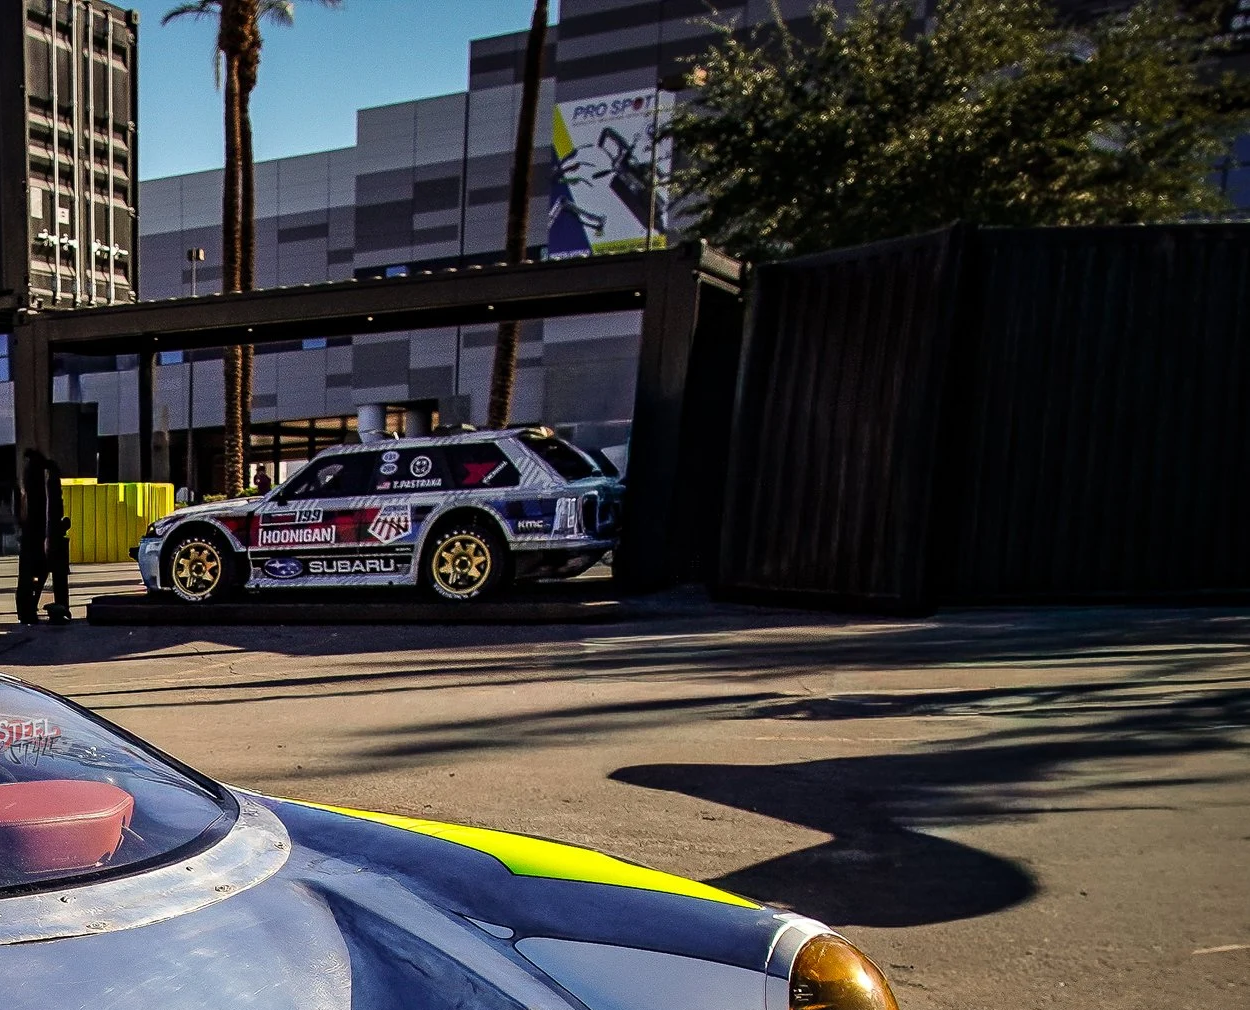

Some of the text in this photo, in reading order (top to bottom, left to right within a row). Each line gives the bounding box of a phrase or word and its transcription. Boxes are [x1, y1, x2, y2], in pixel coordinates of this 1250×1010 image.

[573, 103, 608, 120] PRO
[611, 94, 653, 115] SPOT
[308, 558, 396, 574] SUBARU
